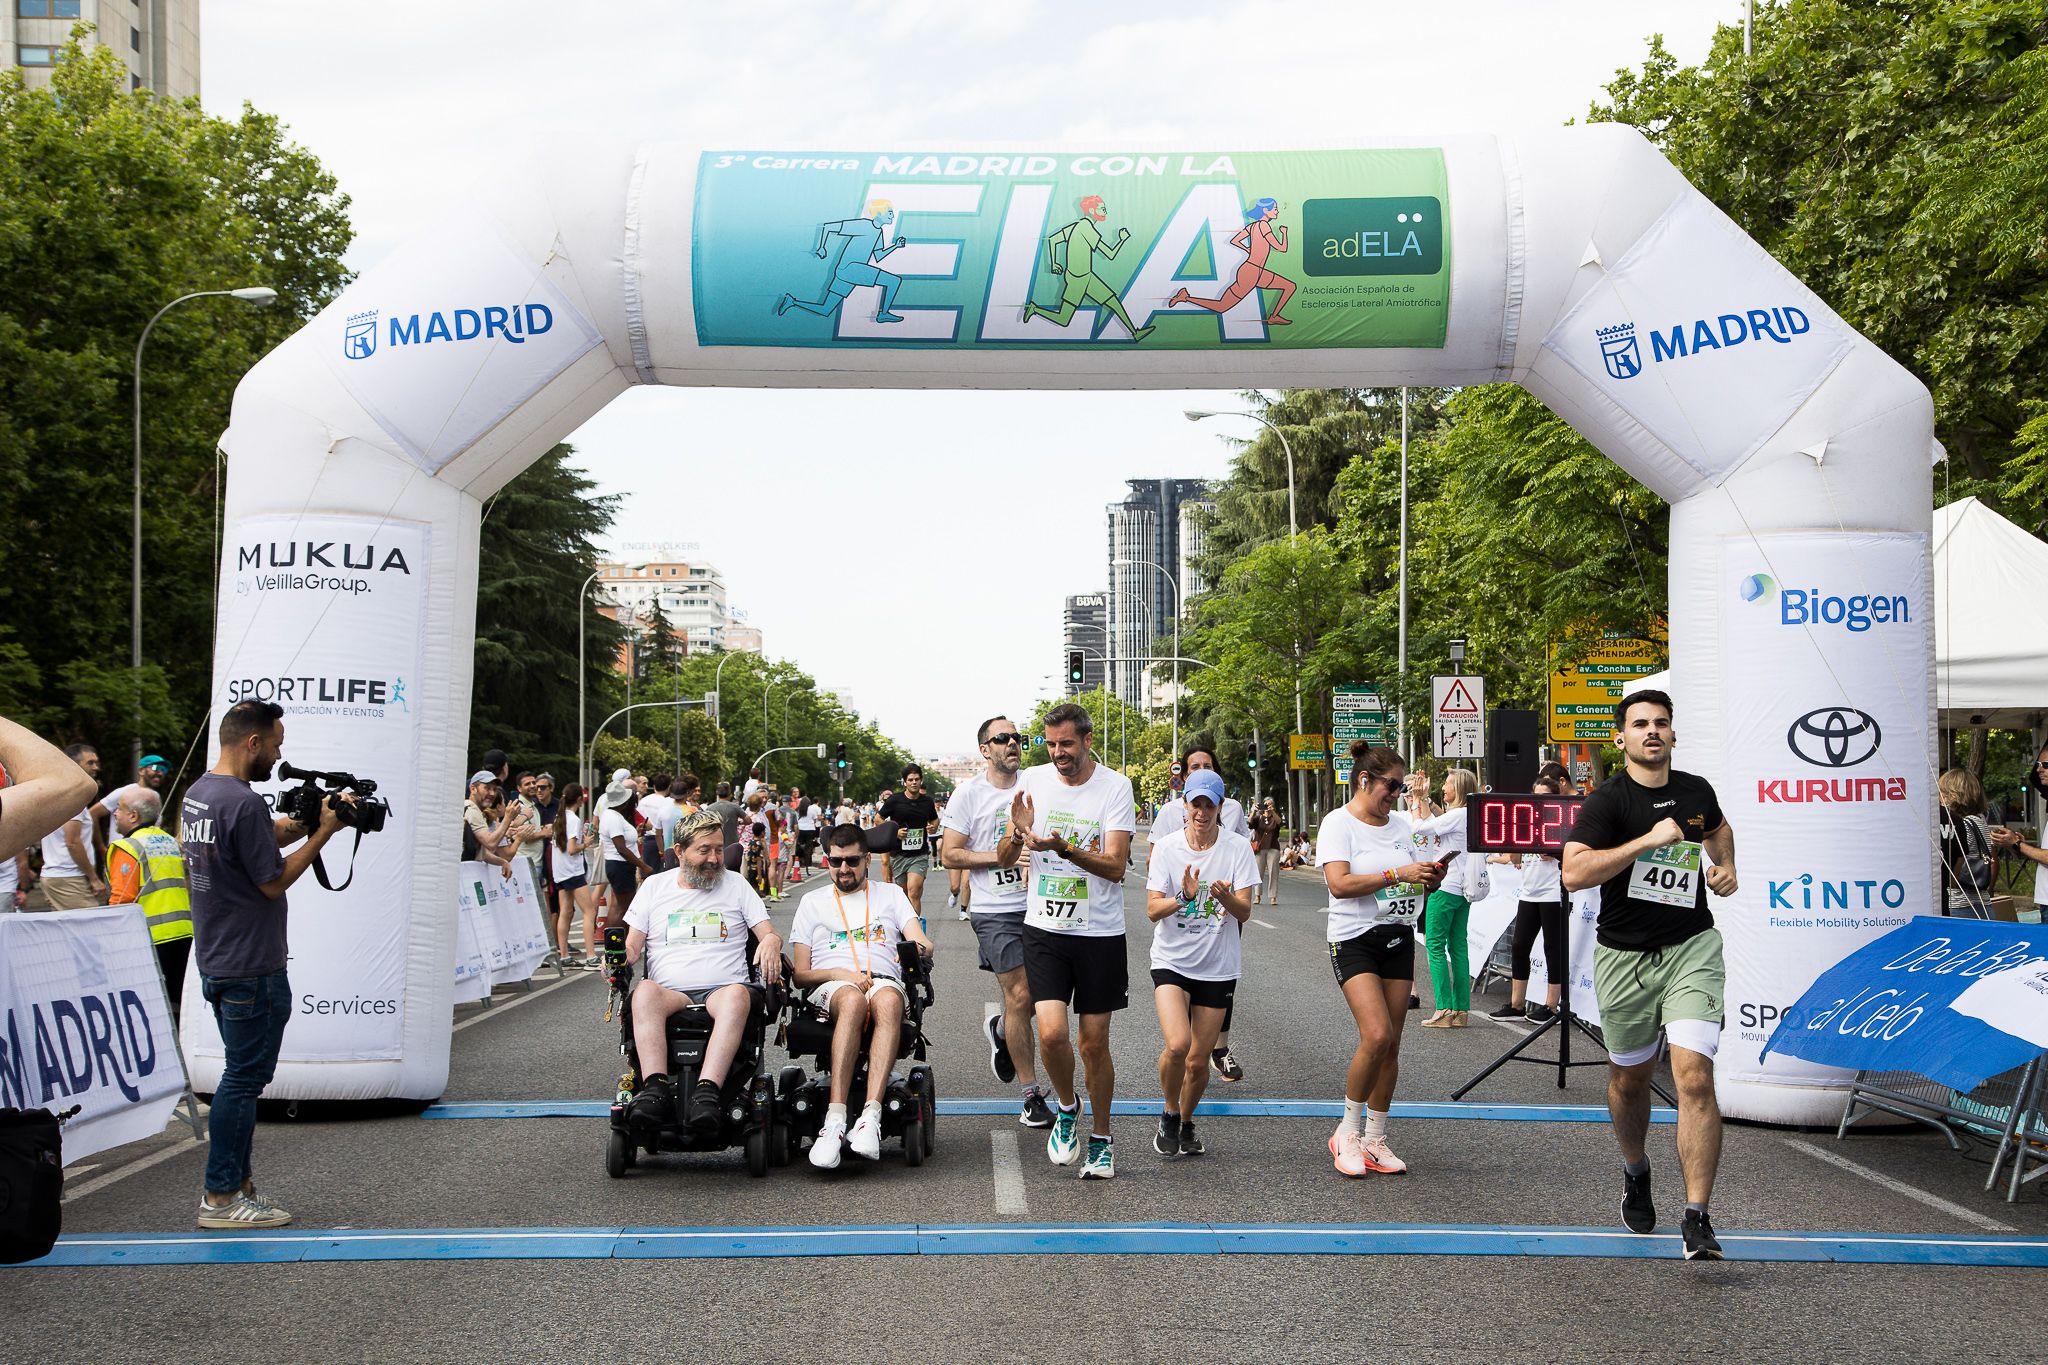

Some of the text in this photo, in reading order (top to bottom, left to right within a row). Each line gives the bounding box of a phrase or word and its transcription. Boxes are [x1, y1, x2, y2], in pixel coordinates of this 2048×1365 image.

[713, 155, 1238, 176] 3ª Carrera MADRID CON LA
[1322, 230, 1423, 258] adELA
[835, 181, 1270, 343] ELA
[1302, 284, 1415, 296] Asociación Española de
[1301, 298, 1442, 309] Esclerosis Lateral Amiotrófica
[389, 303, 553, 347] MADRID
[1650, 306, 1811, 363] MADRID
[238, 541, 411, 575] MUKUA
[237, 580, 250, 597] by
[1076, 596, 1104, 607] BBVA
[1781, 588, 1910, 632] Biogen
[1587, 650, 1651, 658] COMENDADOS
[1597, 665, 1631, 673] Concha
[335, 706, 341, 716] Y
[343, 707, 384, 718] EVENTOS
[1556, 705, 1613, 714] av. General
[1575, 730, 1610, 738] c/Orense
[1048, 815, 1075, 823] MADRID
[904, 838, 922, 846] 1668
[995, 867, 1023, 886] 151
[1642, 866, 1690, 893] 404
[1046, 899, 1078, 918] 577
[1388, 898, 1416, 916] 235
[690, 925, 697, 938] 1
[1770, 916, 1907, 930] Flexible Mobility Solutions
[1881, 937, 1952, 973] De
[301, 994, 397, 1015] Services
[1838, 988, 1930, 1041] Cielo
[0, 989, 156, 1110] MADRID
